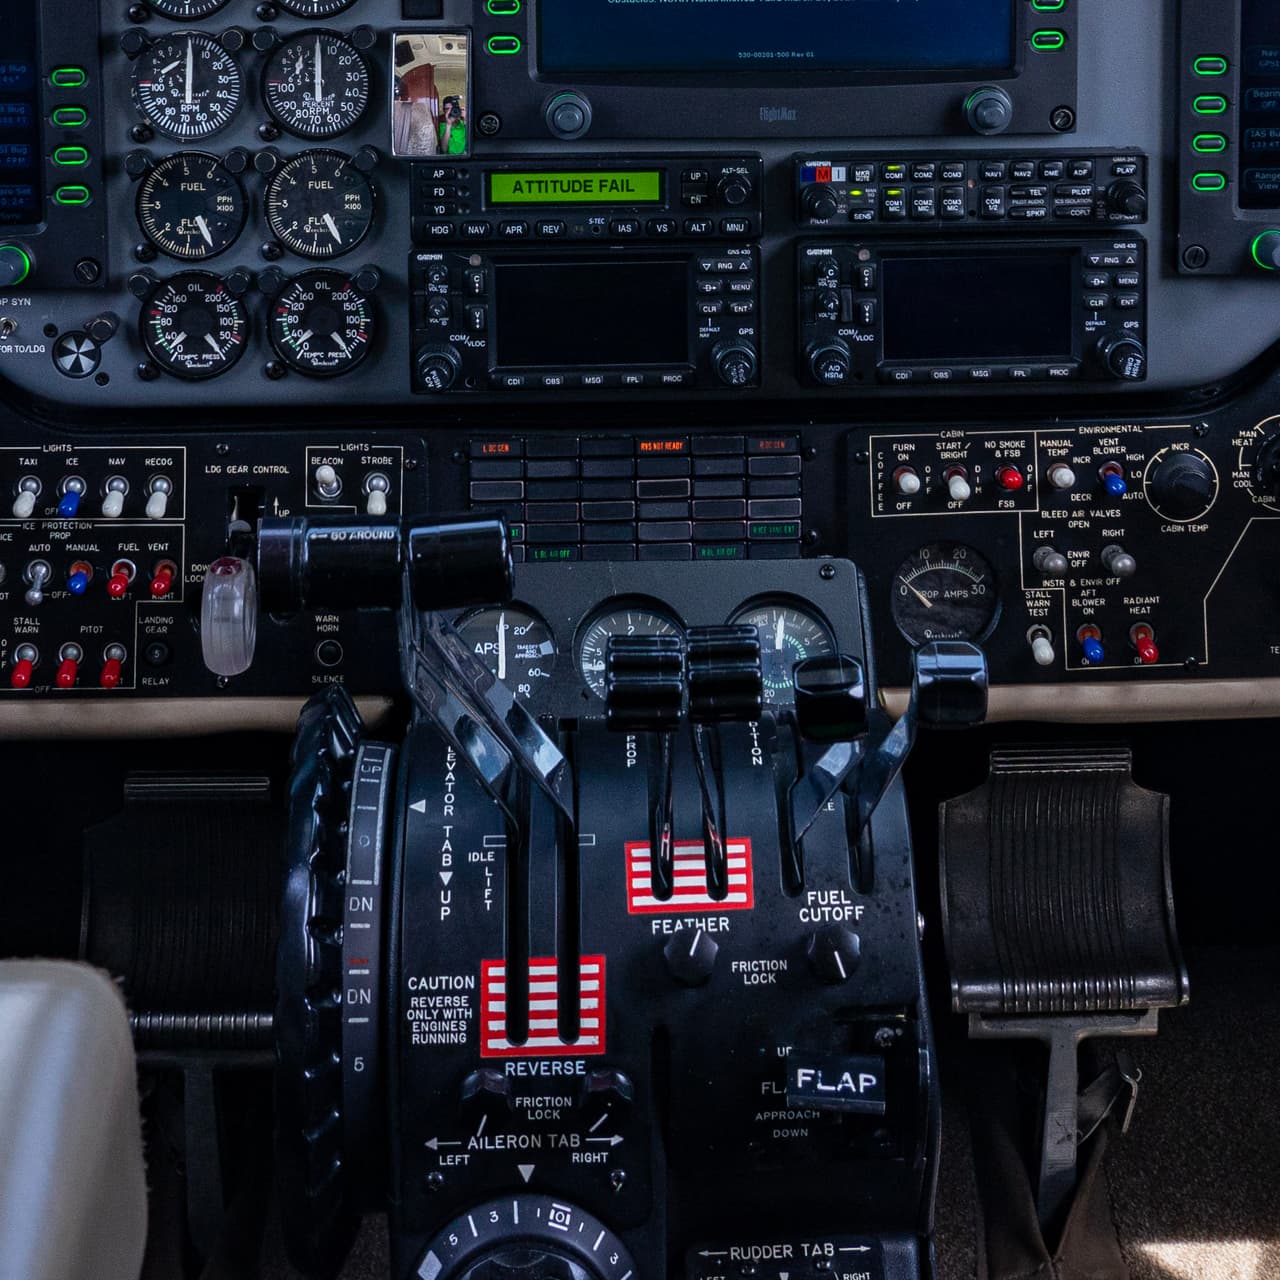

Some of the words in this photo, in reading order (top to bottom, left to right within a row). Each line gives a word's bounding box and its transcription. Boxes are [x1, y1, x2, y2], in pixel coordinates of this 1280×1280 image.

[181, 182, 206, 191] FUEL
[308, 181, 334, 189] FUEL
[512, 179, 593, 194] ATTITUDE
[598, 179, 635, 193] FAIL
[431, 226, 449, 234] HDG
[468, 226, 485, 234] NAV
[505, 225, 522, 234] APR
[543, 225, 560, 234] REV
[618, 224, 632, 232] IAS
[691, 223, 706, 232] ALT
[726, 223, 744, 232] MNU
[940, 430, 965, 438] CABIN
[1079, 425, 1143, 434] ENVIRONMENTAL
[43, 444, 72, 452] LIGHTS
[340, 443, 369, 451] LIGHTS
[1040, 440, 1073, 448] MANUAL
[1047, 448, 1069, 456] TEMP
[361, 456, 393, 465] STROBE
[1126, 453, 1145, 461] HIGH
[145, 458, 173, 466] RECOG
[205, 465, 223, 473] LDG
[226, 465, 248, 474] GEAR
[253, 465, 289, 474] CONTROL
[1041, 510, 1068, 518] BLEED
[1072, 510, 1086, 518] AIR
[1090, 509, 1121, 517] VALVES
[1068, 520, 1090, 528] OPEN
[1161, 524, 1185, 533] CABIN
[1188, 524, 1208, 532] TEMP
[331, 531, 346, 541] GO
[350, 530, 394, 540] AROUND
[1033, 530, 1054, 538] LEFT
[1102, 529, 1125, 537] RIGHT
[28, 544, 51, 552] AUTO
[66, 544, 100, 552] MANUAL
[118, 543, 140, 551] FUEL
[148, 543, 168, 551] VENT
[1123, 596, 1159, 605] RADIANT
[1130, 606, 1151, 614] HEAT
[807, 890, 850, 906] FUEL
[799, 905, 864, 922] CUTOFF
[732, 960, 787, 974] FRICTION
[408, 975, 475, 990] CAUTION
[743, 973, 776, 985] LOCK
[411, 995, 469, 1008] REVERSE
[407, 1009, 440, 1020] ONLY
[443, 1008, 472, 1020] WITH
[411, 1020, 467, 1032] ENGINES
[412, 1032, 467, 1044] RUNNING
[504, 1060, 586, 1078] REVERSE
[796, 1068, 876, 1093] FLAP
[515, 1096, 572, 1109] FRICTION
[527, 1108, 560, 1120] LOCK
[467, 1133, 541, 1150] AILERON
[546, 1133, 582, 1149] TAB
[439, 1154, 470, 1166] LEFT
[572, 1152, 608, 1164] RIGHT
[730, 1244, 793, 1260] RUDDER
[798, 1243, 834, 1258] TAB
